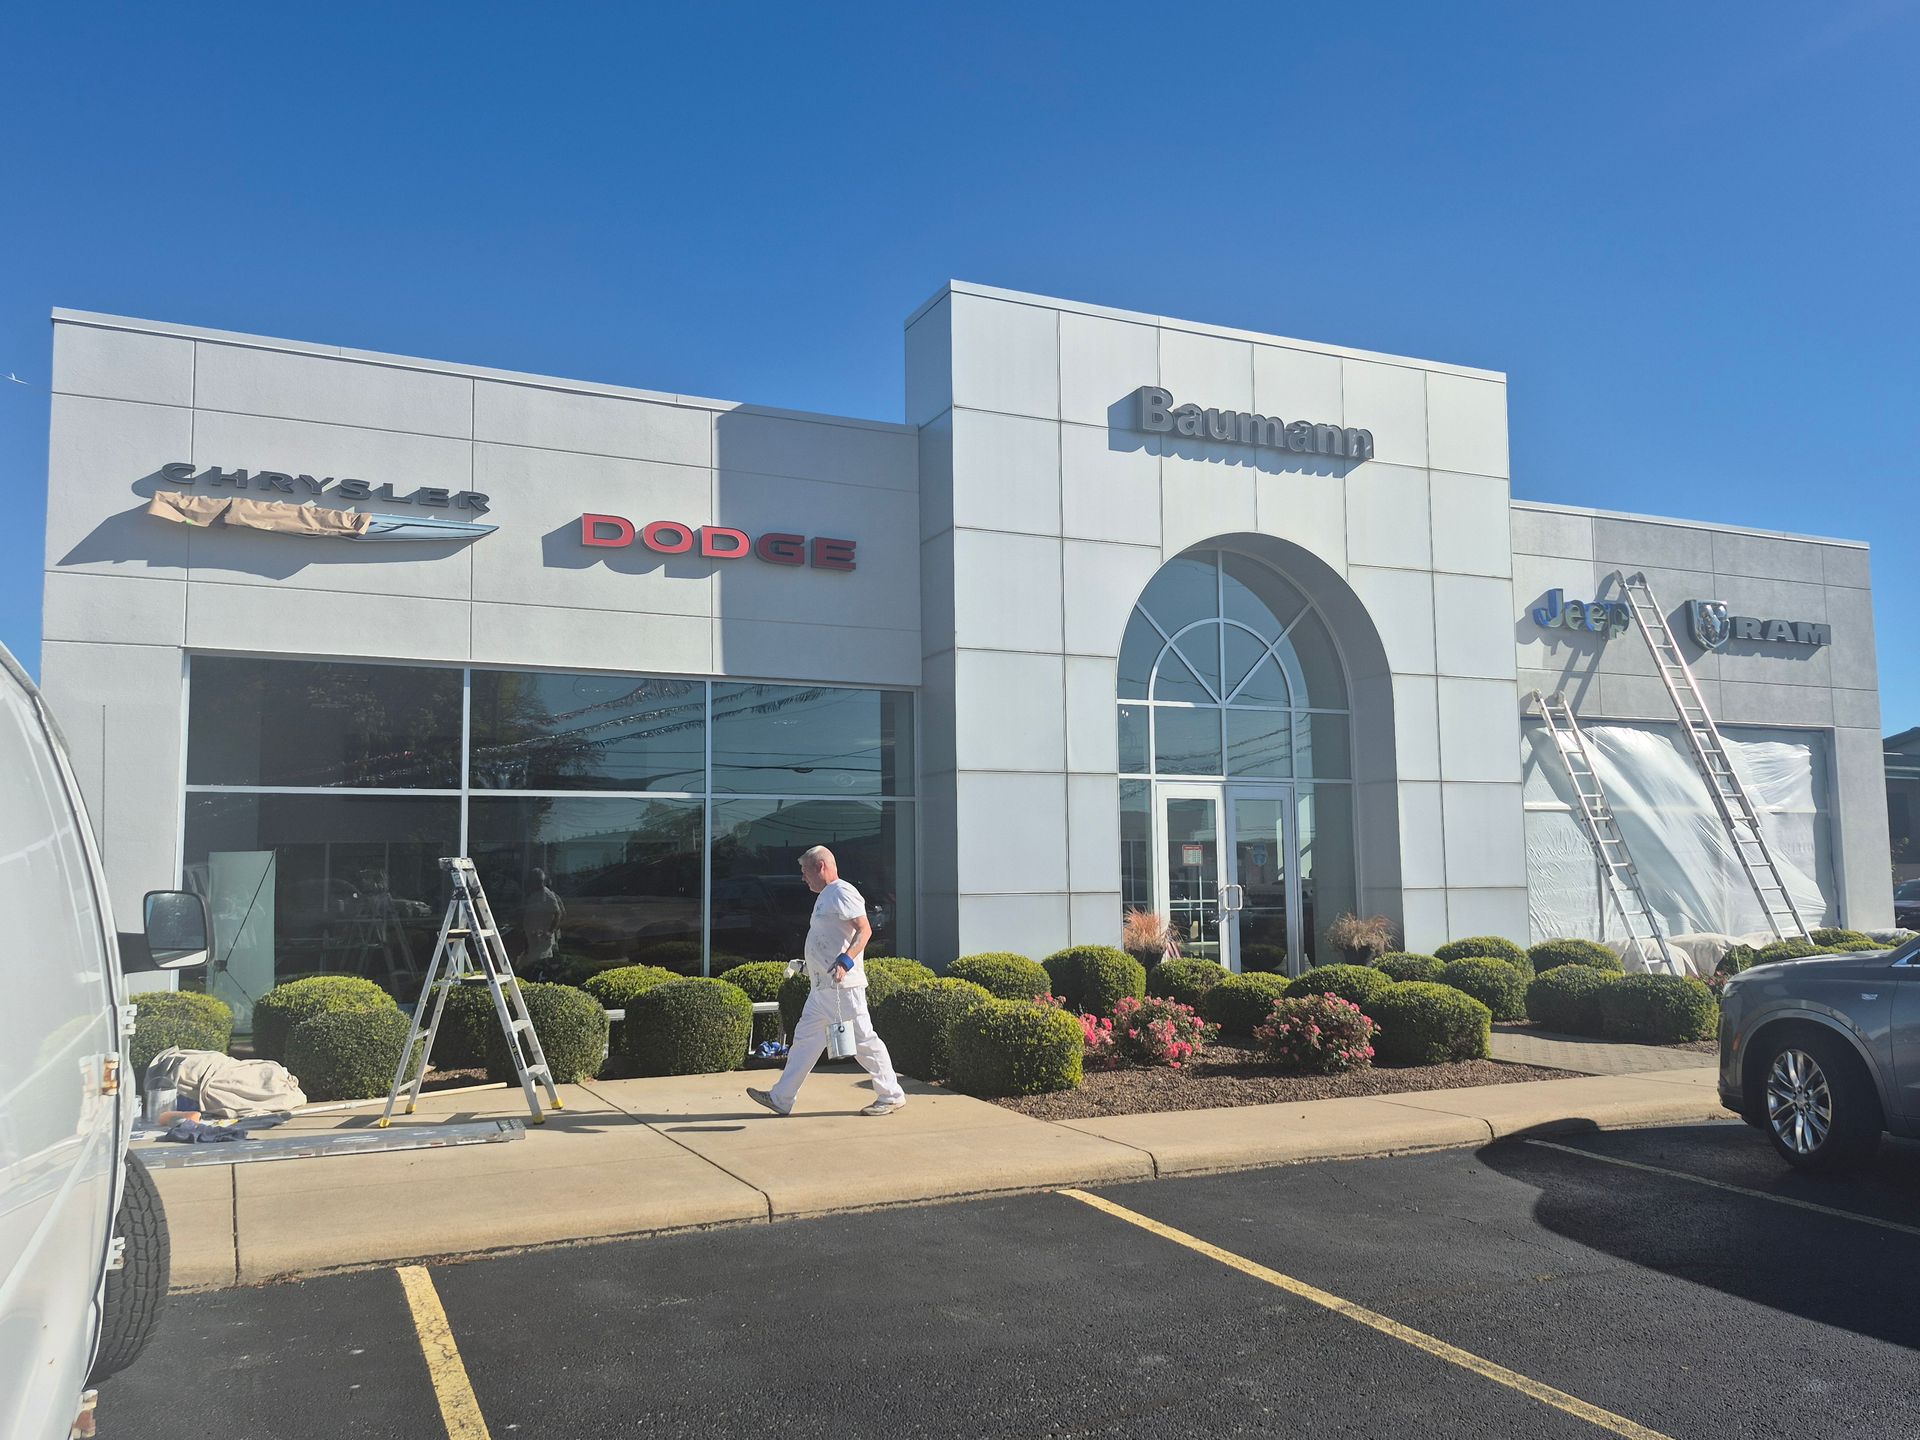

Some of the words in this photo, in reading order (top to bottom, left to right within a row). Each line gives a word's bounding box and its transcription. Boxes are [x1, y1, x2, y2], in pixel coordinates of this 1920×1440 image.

[1141, 385, 1375, 459] Baumann
[159, 461, 491, 512] CHRYSLER
[581, 512, 857, 572] DODGE
[1533, 588, 1630, 640] Jeep
[1734, 616, 1831, 645] RAM
